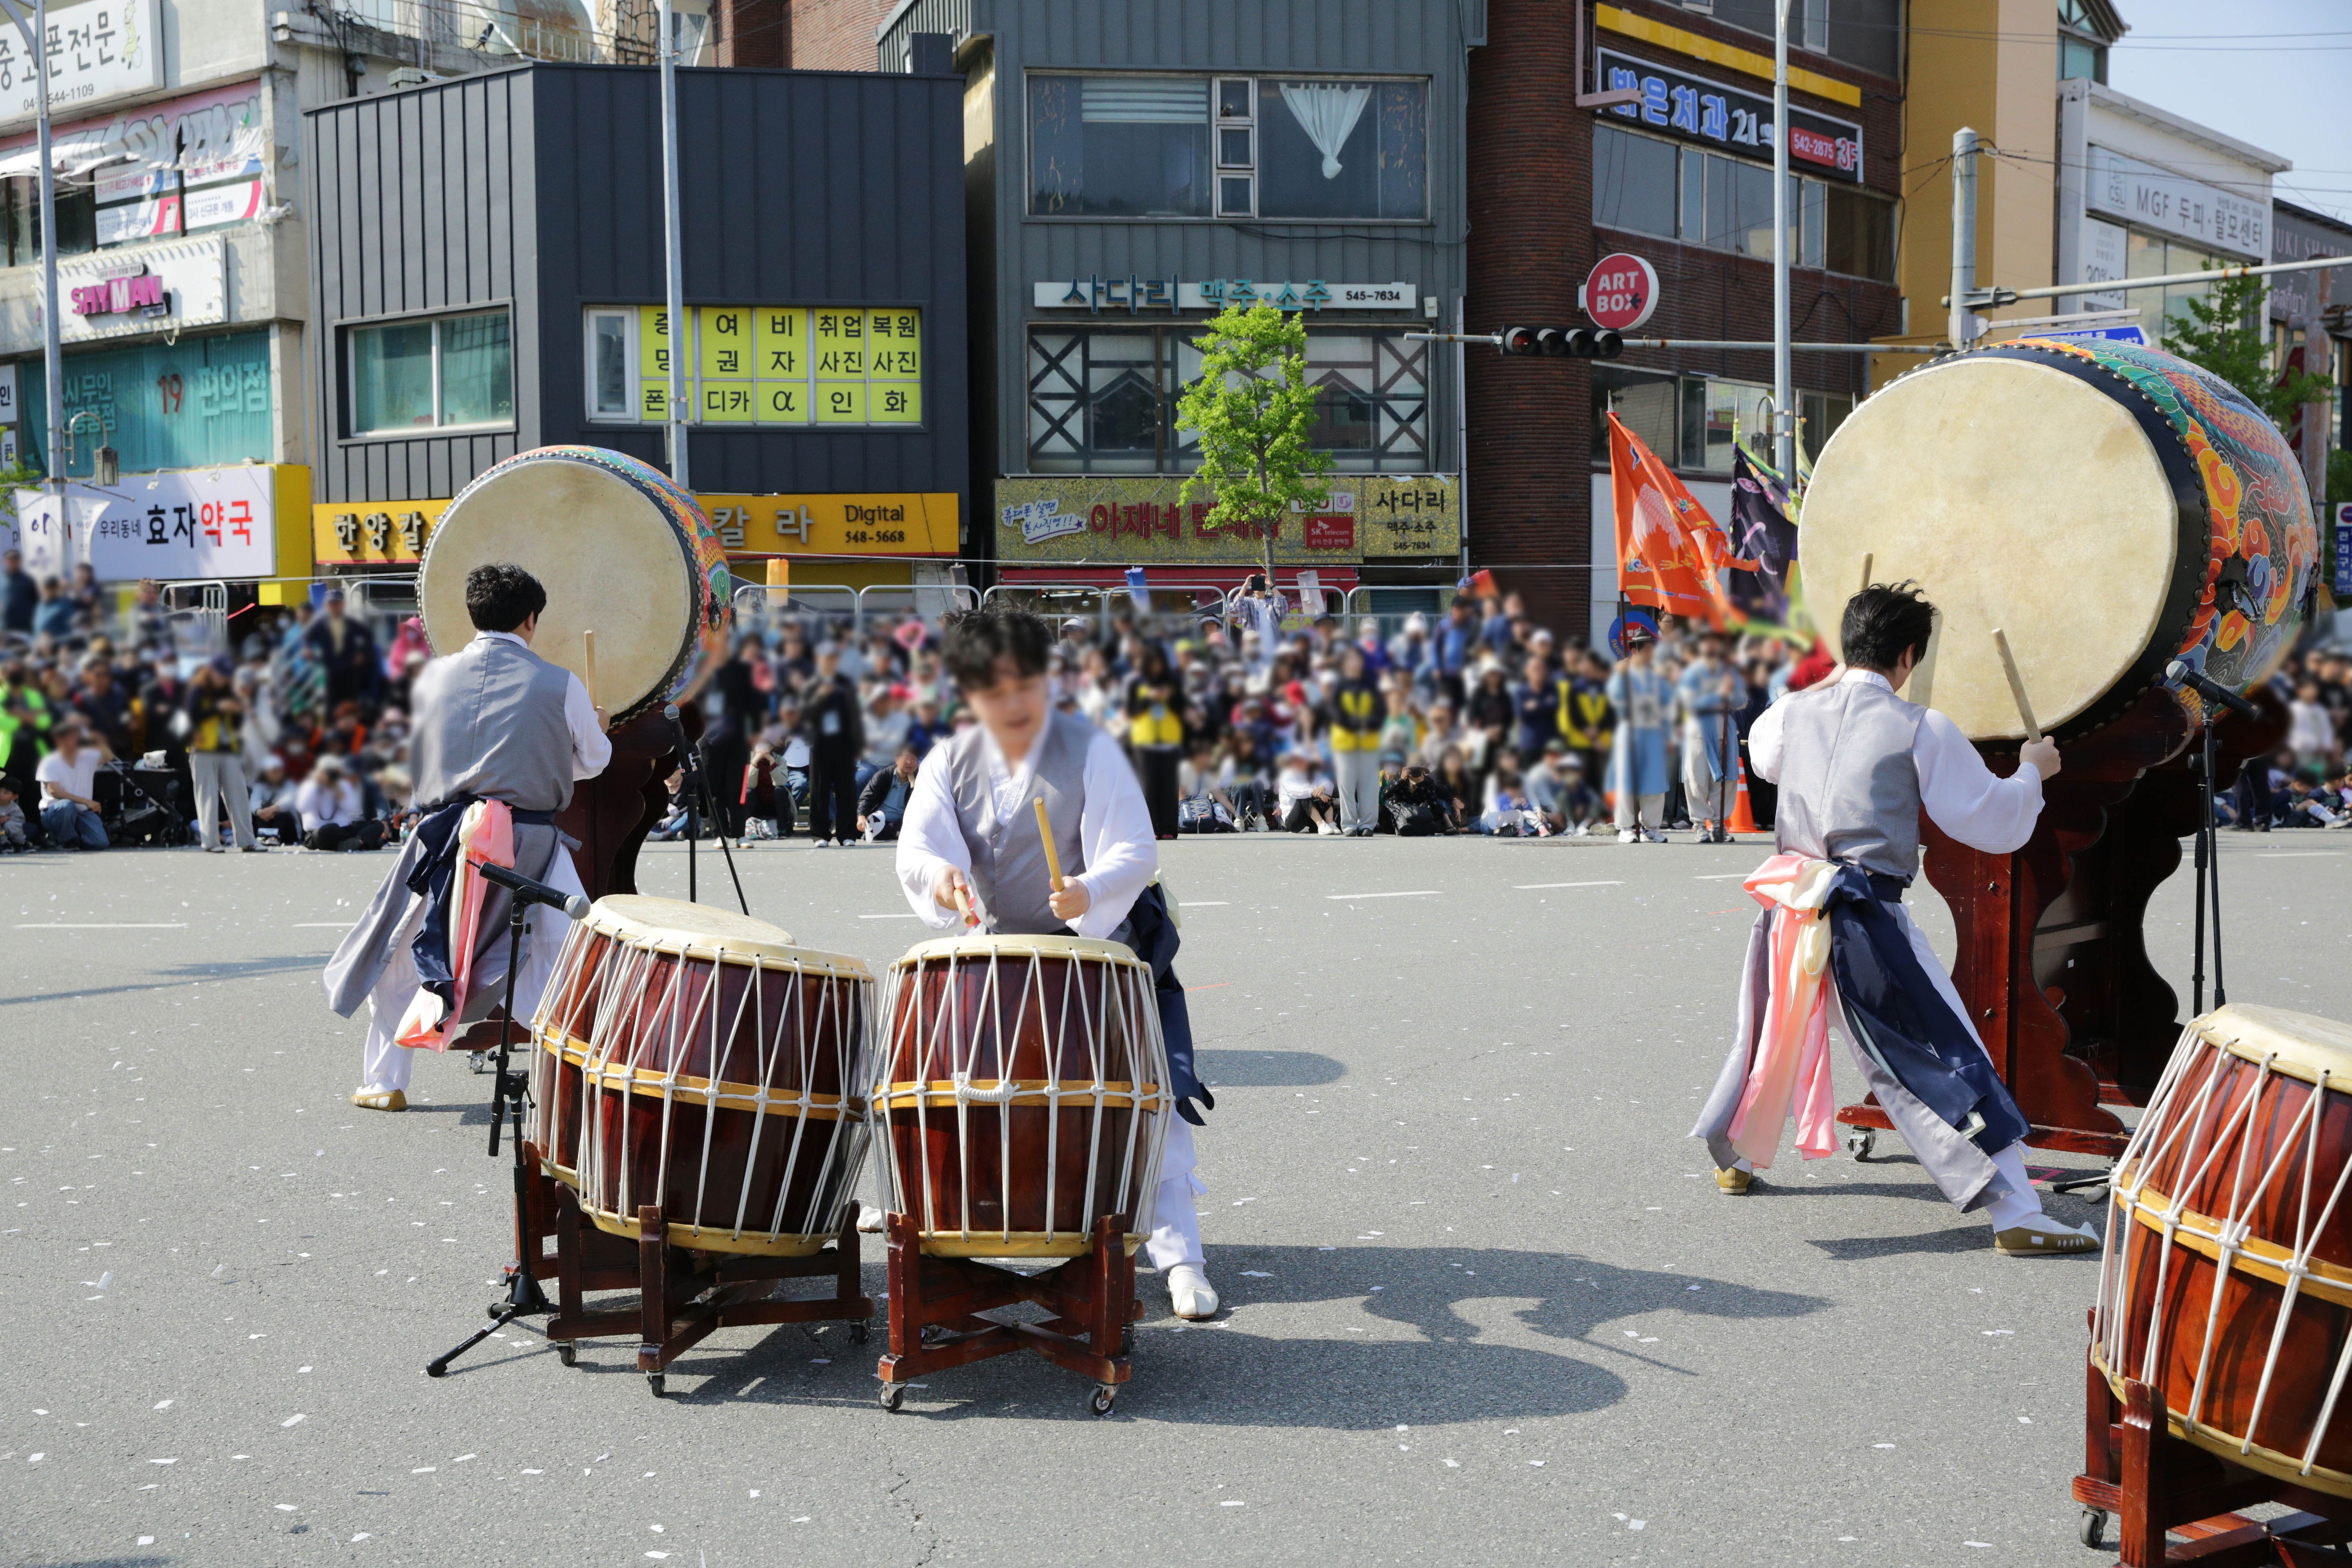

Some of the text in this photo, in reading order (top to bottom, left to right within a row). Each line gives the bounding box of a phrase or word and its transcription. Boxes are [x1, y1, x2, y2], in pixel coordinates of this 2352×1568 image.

[24, 83, 94, 110] 04544-1109
[1732, 109, 1759, 147] 21
[1794, 133, 1834, 159] 542-2875
[1837, 137, 1858, 171] 3F
[2137, 185, 2169, 218] MGF
[1598, 271, 1639, 292] ART
[71, 275, 163, 315] SHYMAN
[1062, 274, 1401, 314] 사다리 맥주·소주 545-7634
[1596, 293, 1637, 313] BOX
[819, 315, 861, 337] 취업
[873, 316, 915, 337] 복원
[820, 351, 862, 373] 사진
[873, 351, 916, 373] 사진
[82, 372, 112, 403] 무인
[158, 374, 183, 414] 19
[198, 361, 267, 416] 편의점
[708, 391, 749, 412] 디카
[1376, 489, 1444, 513] 사다리
[844, 505, 904, 525] Digital
[1090, 501, 1182, 539] 아재네
[100, 519, 141, 539] 우리동네
[333, 511, 443, 551] 한양칼
[845, 530, 905, 543] 548-5668
[1387, 521, 1437, 535] 맥주·소주
[1394, 542, 1431, 550] 545-7634
[1433, 558, 1444, 566] 2F
